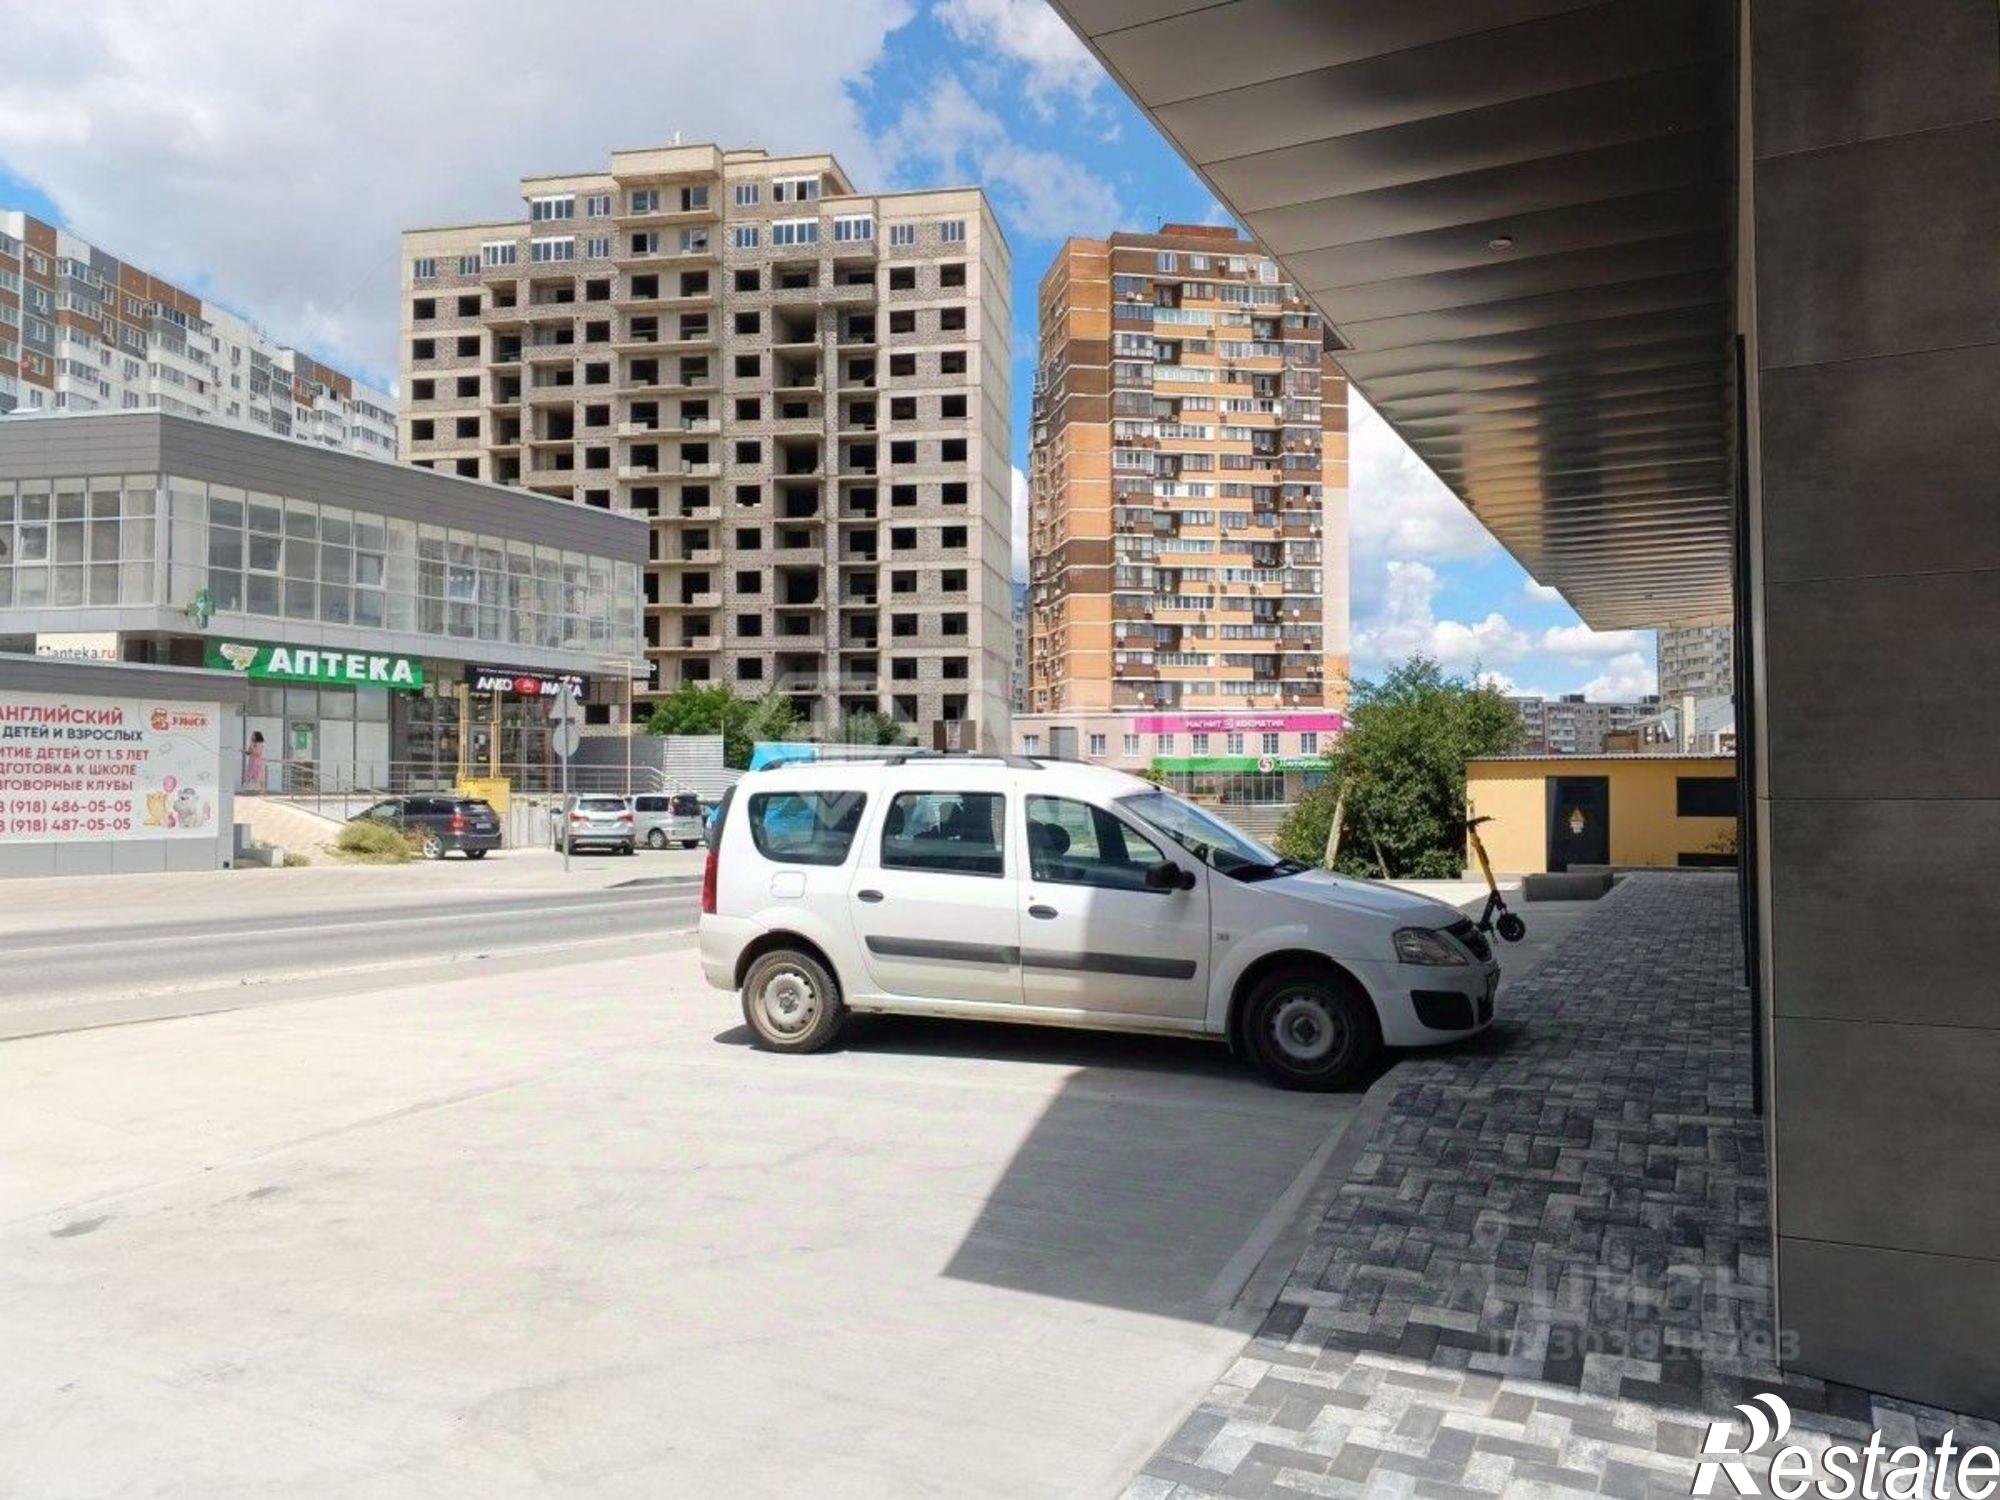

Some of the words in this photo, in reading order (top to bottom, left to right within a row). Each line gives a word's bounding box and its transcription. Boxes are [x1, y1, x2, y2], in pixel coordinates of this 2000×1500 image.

[268, 648, 414, 684] АПТЕКА
[476, 676, 513, 692] АЛКО
[2, 725, 49, 739] ДЕТЕЙ
[53, 728, 63, 739] И
[67, 728, 143, 742] ВЗРОСЛЫХ
[36, 746, 80, 760] ДЕТЕЙ
[84, 749, 102, 760] ОТ
[107, 749, 123, 761] 1.5
[126, 749, 150, 762] ЛЕТ
[76, 764, 84, 774] К
[89, 764, 137, 776] ШКОЛЕ
[86, 780, 133, 792] КЛУБЫ
[10, 799, 47, 814] (918)
[51, 800, 133, 813] 486-05-05
[10, 818, 47, 833] (918)
[51, 818, 131, 831] 487-05-05
